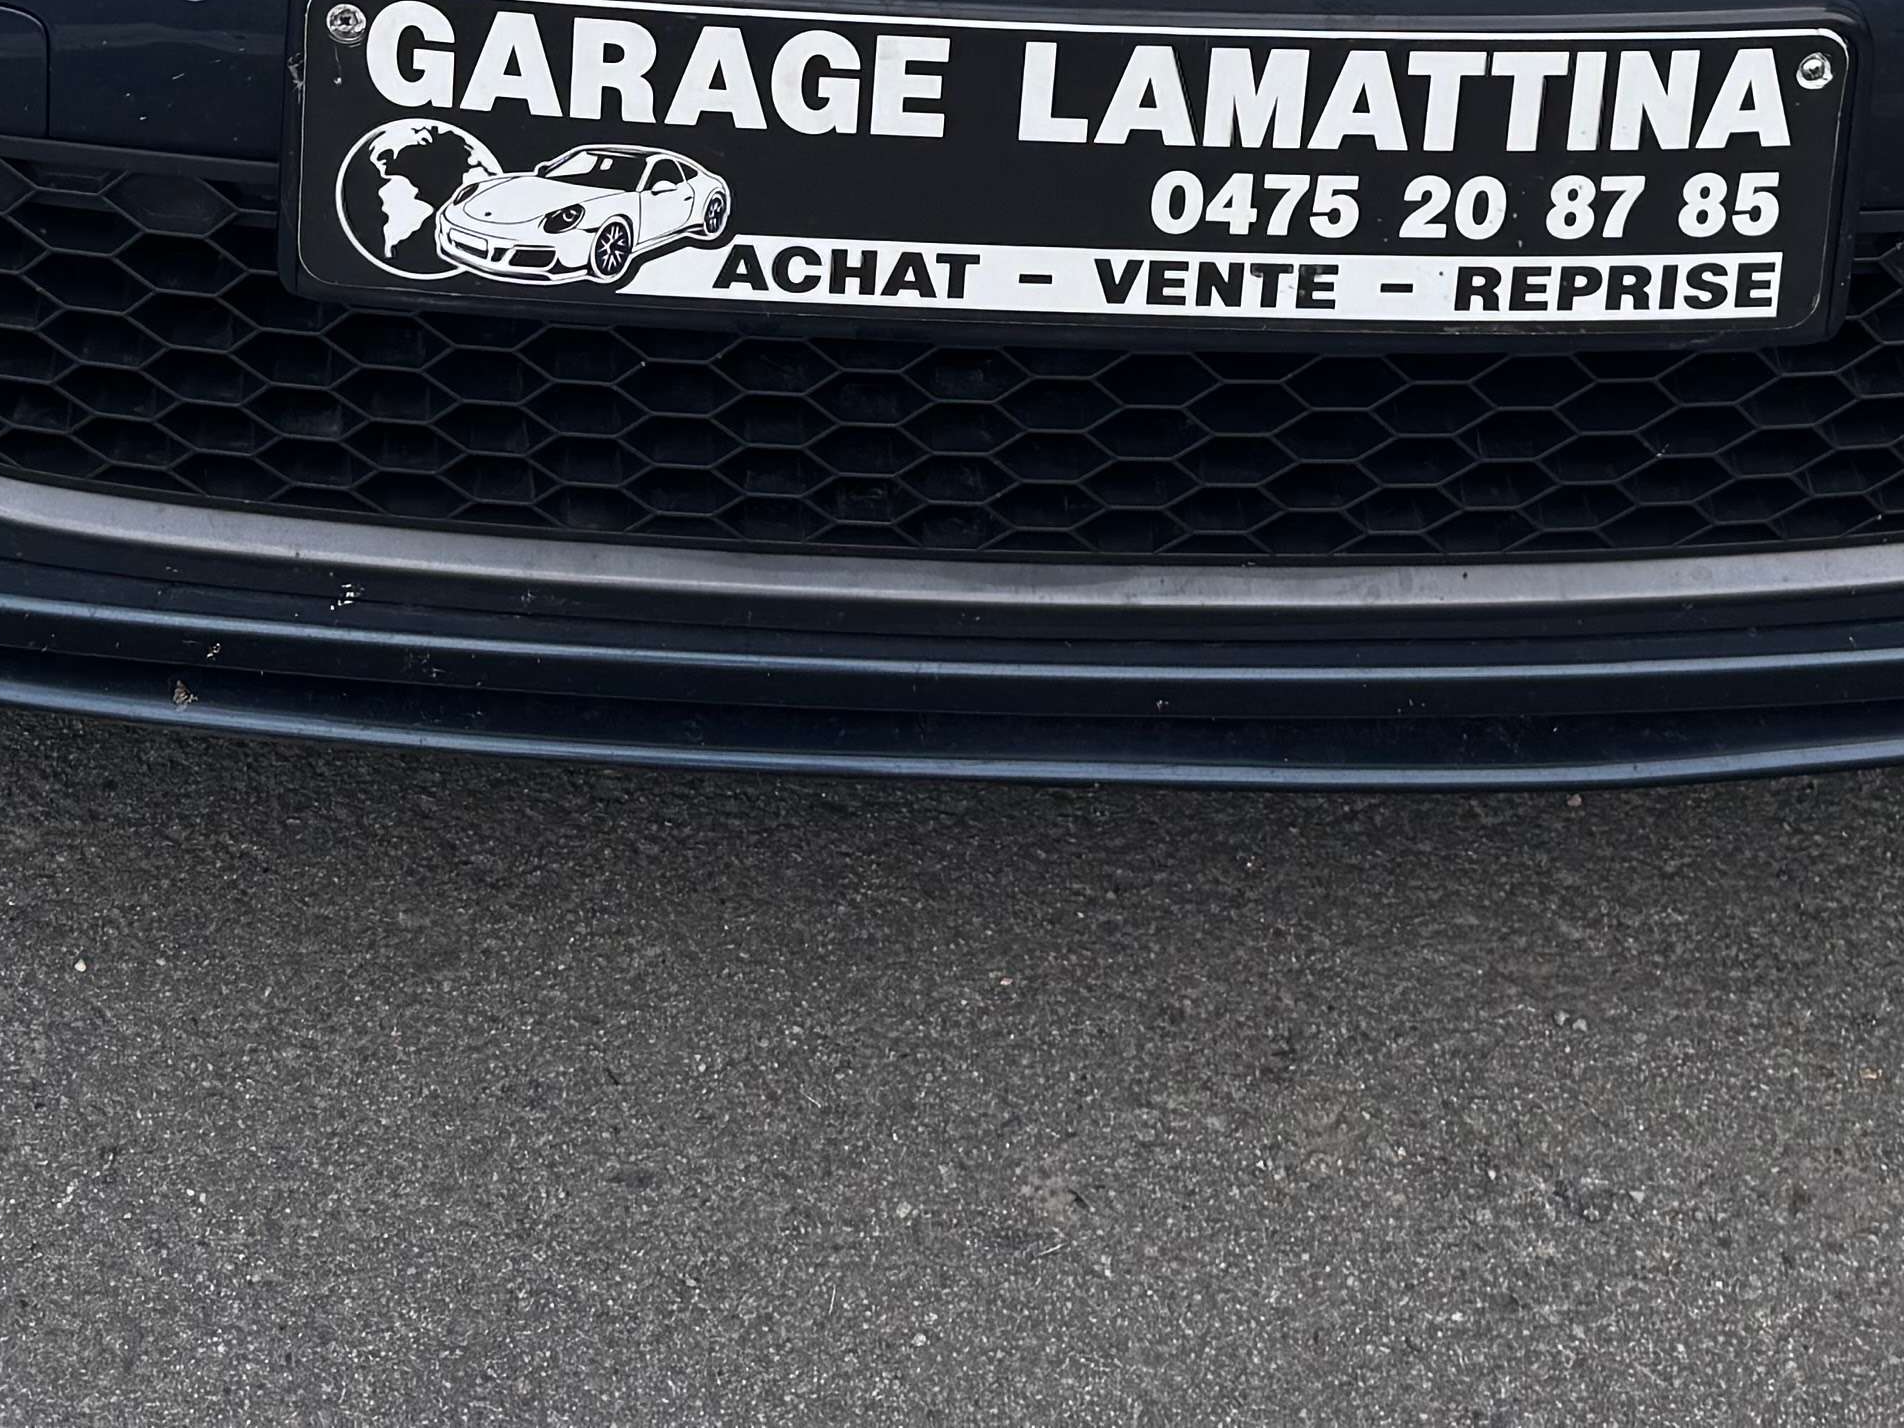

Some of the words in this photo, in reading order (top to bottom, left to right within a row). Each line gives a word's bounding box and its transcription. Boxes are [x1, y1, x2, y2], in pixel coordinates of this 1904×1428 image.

[367, 1, 951, 138] GARAGE
[1019, 42, 1791, 152] LAMATTINA
[1151, 171, 1360, 239] 0475
[1399, 176, 1507, 240] 20
[1546, 175, 1646, 240] 87
[1679, 172, 1780, 238] 85
[713, 244, 981, 299] ACHAT
[1095, 259, 1339, 310] VENTE
[1455, 263, 1776, 312] REPRISE
